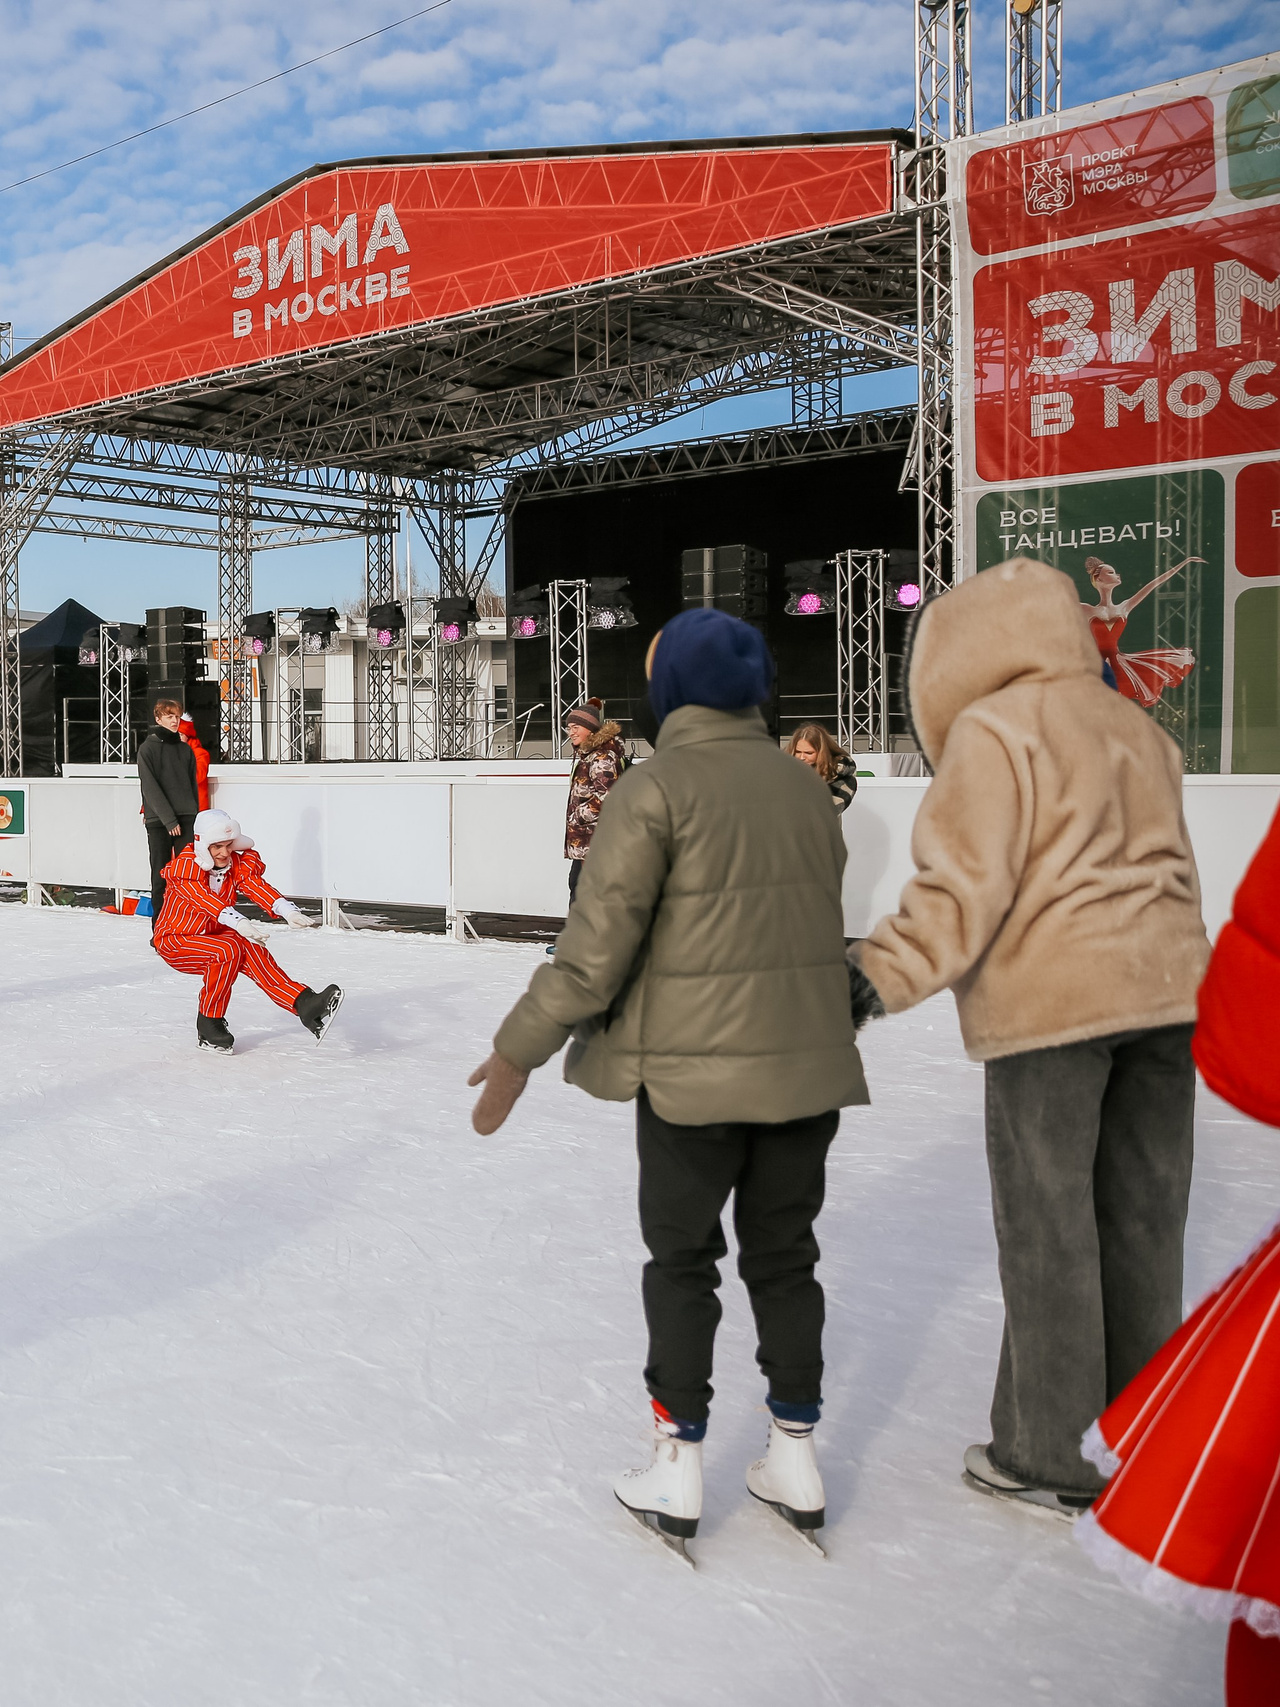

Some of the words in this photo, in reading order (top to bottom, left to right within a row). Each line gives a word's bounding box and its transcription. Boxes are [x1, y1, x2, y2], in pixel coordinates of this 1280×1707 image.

[1081, 143, 1139, 167] ПРОЕКТ
[1082, 162, 1124, 182] МЭРА
[1083, 170, 1148, 196] МОСКВЫ
[231, 202, 411, 300] ЗИМА
[232, 308, 253, 339] В
[263, 264, 412, 331] МОСКВЕ
[1030, 391, 1075, 438] В
[1103, 360, 1280, 430] МОС
[999, 507, 1057, 528] ВСЕ
[998, 519, 1181, 551] ТАНЦЕВАТЬ!
